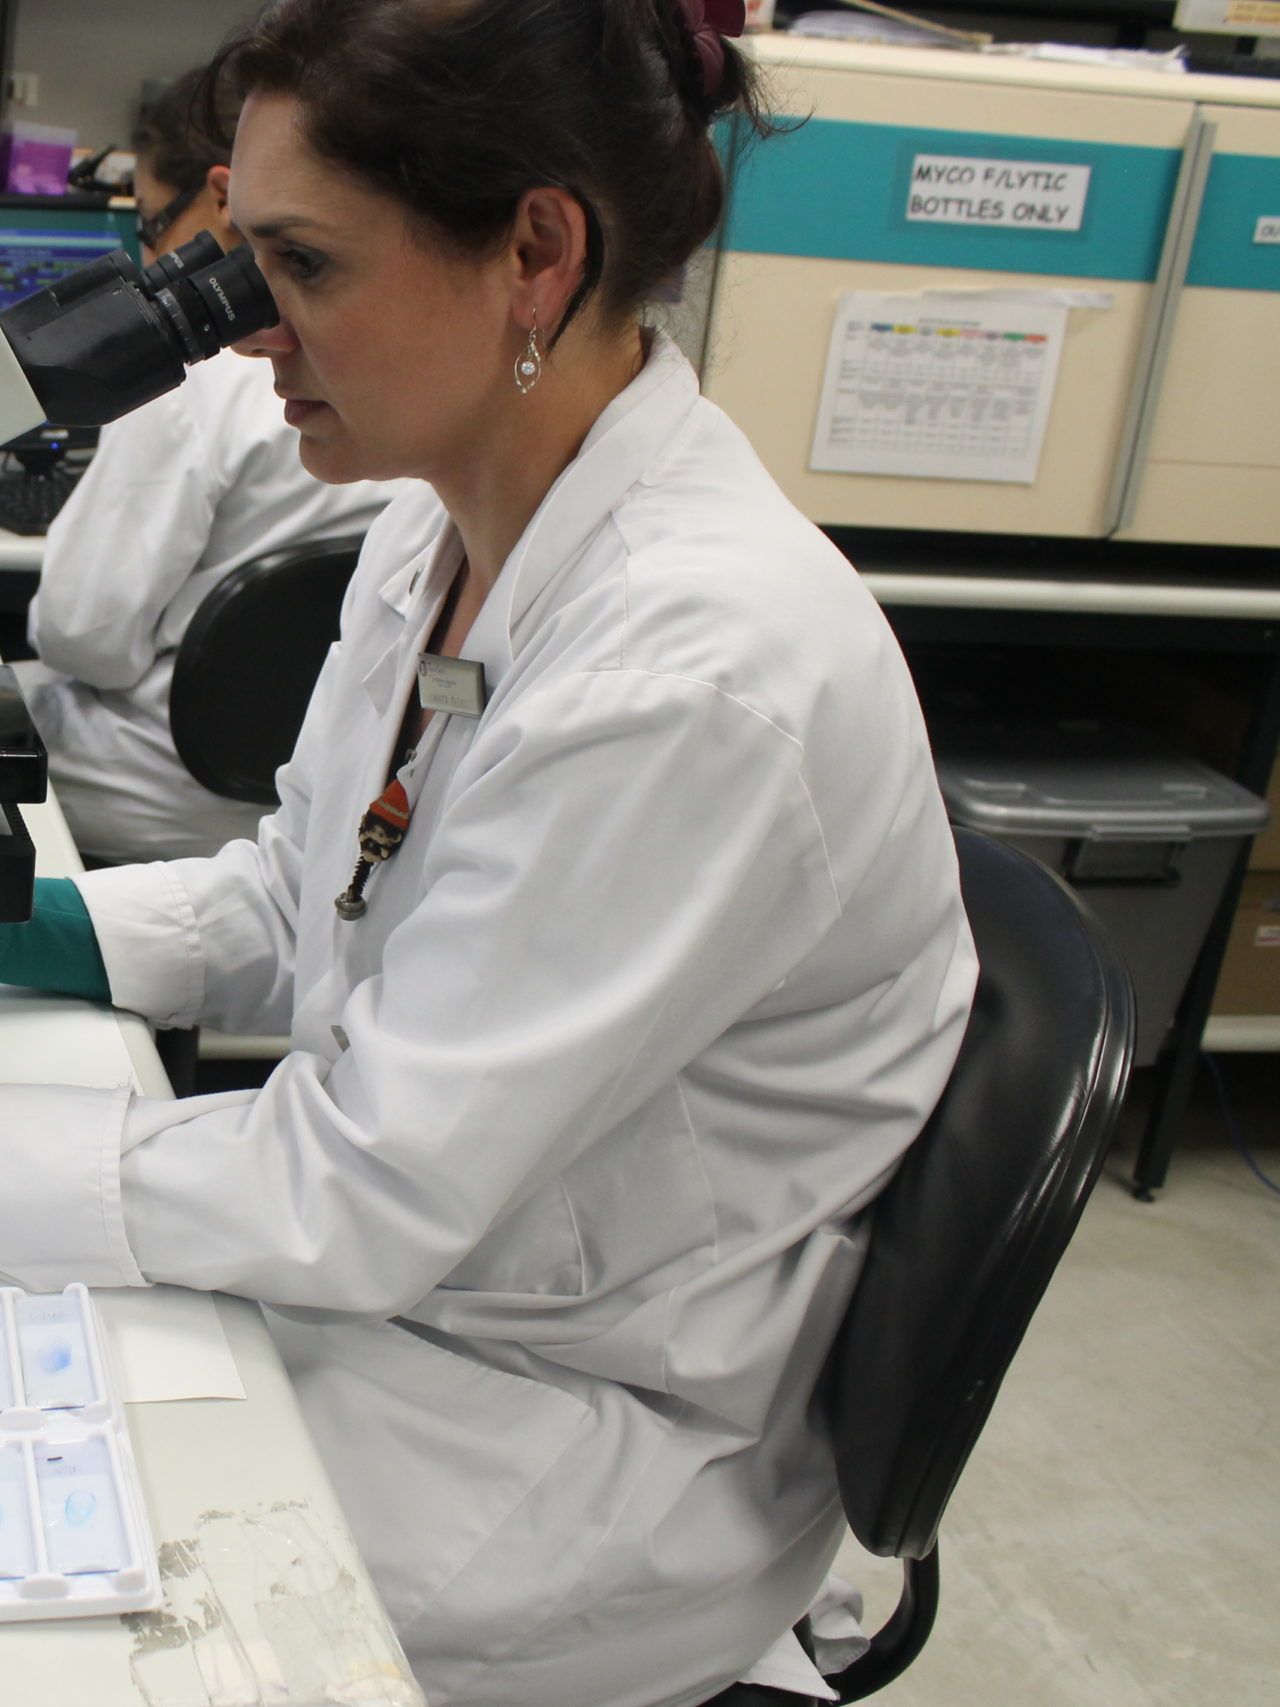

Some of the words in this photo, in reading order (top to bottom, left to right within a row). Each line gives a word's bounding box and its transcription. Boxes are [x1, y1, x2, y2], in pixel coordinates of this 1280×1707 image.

[915, 163, 976, 185] MYCO
[983, 168, 1068, 191] F/LYTIC
[910, 195, 1005, 220] BOTTLES
[1012, 202, 1070, 224] ONLY
[209, 276, 237, 322] OLYMPUS
